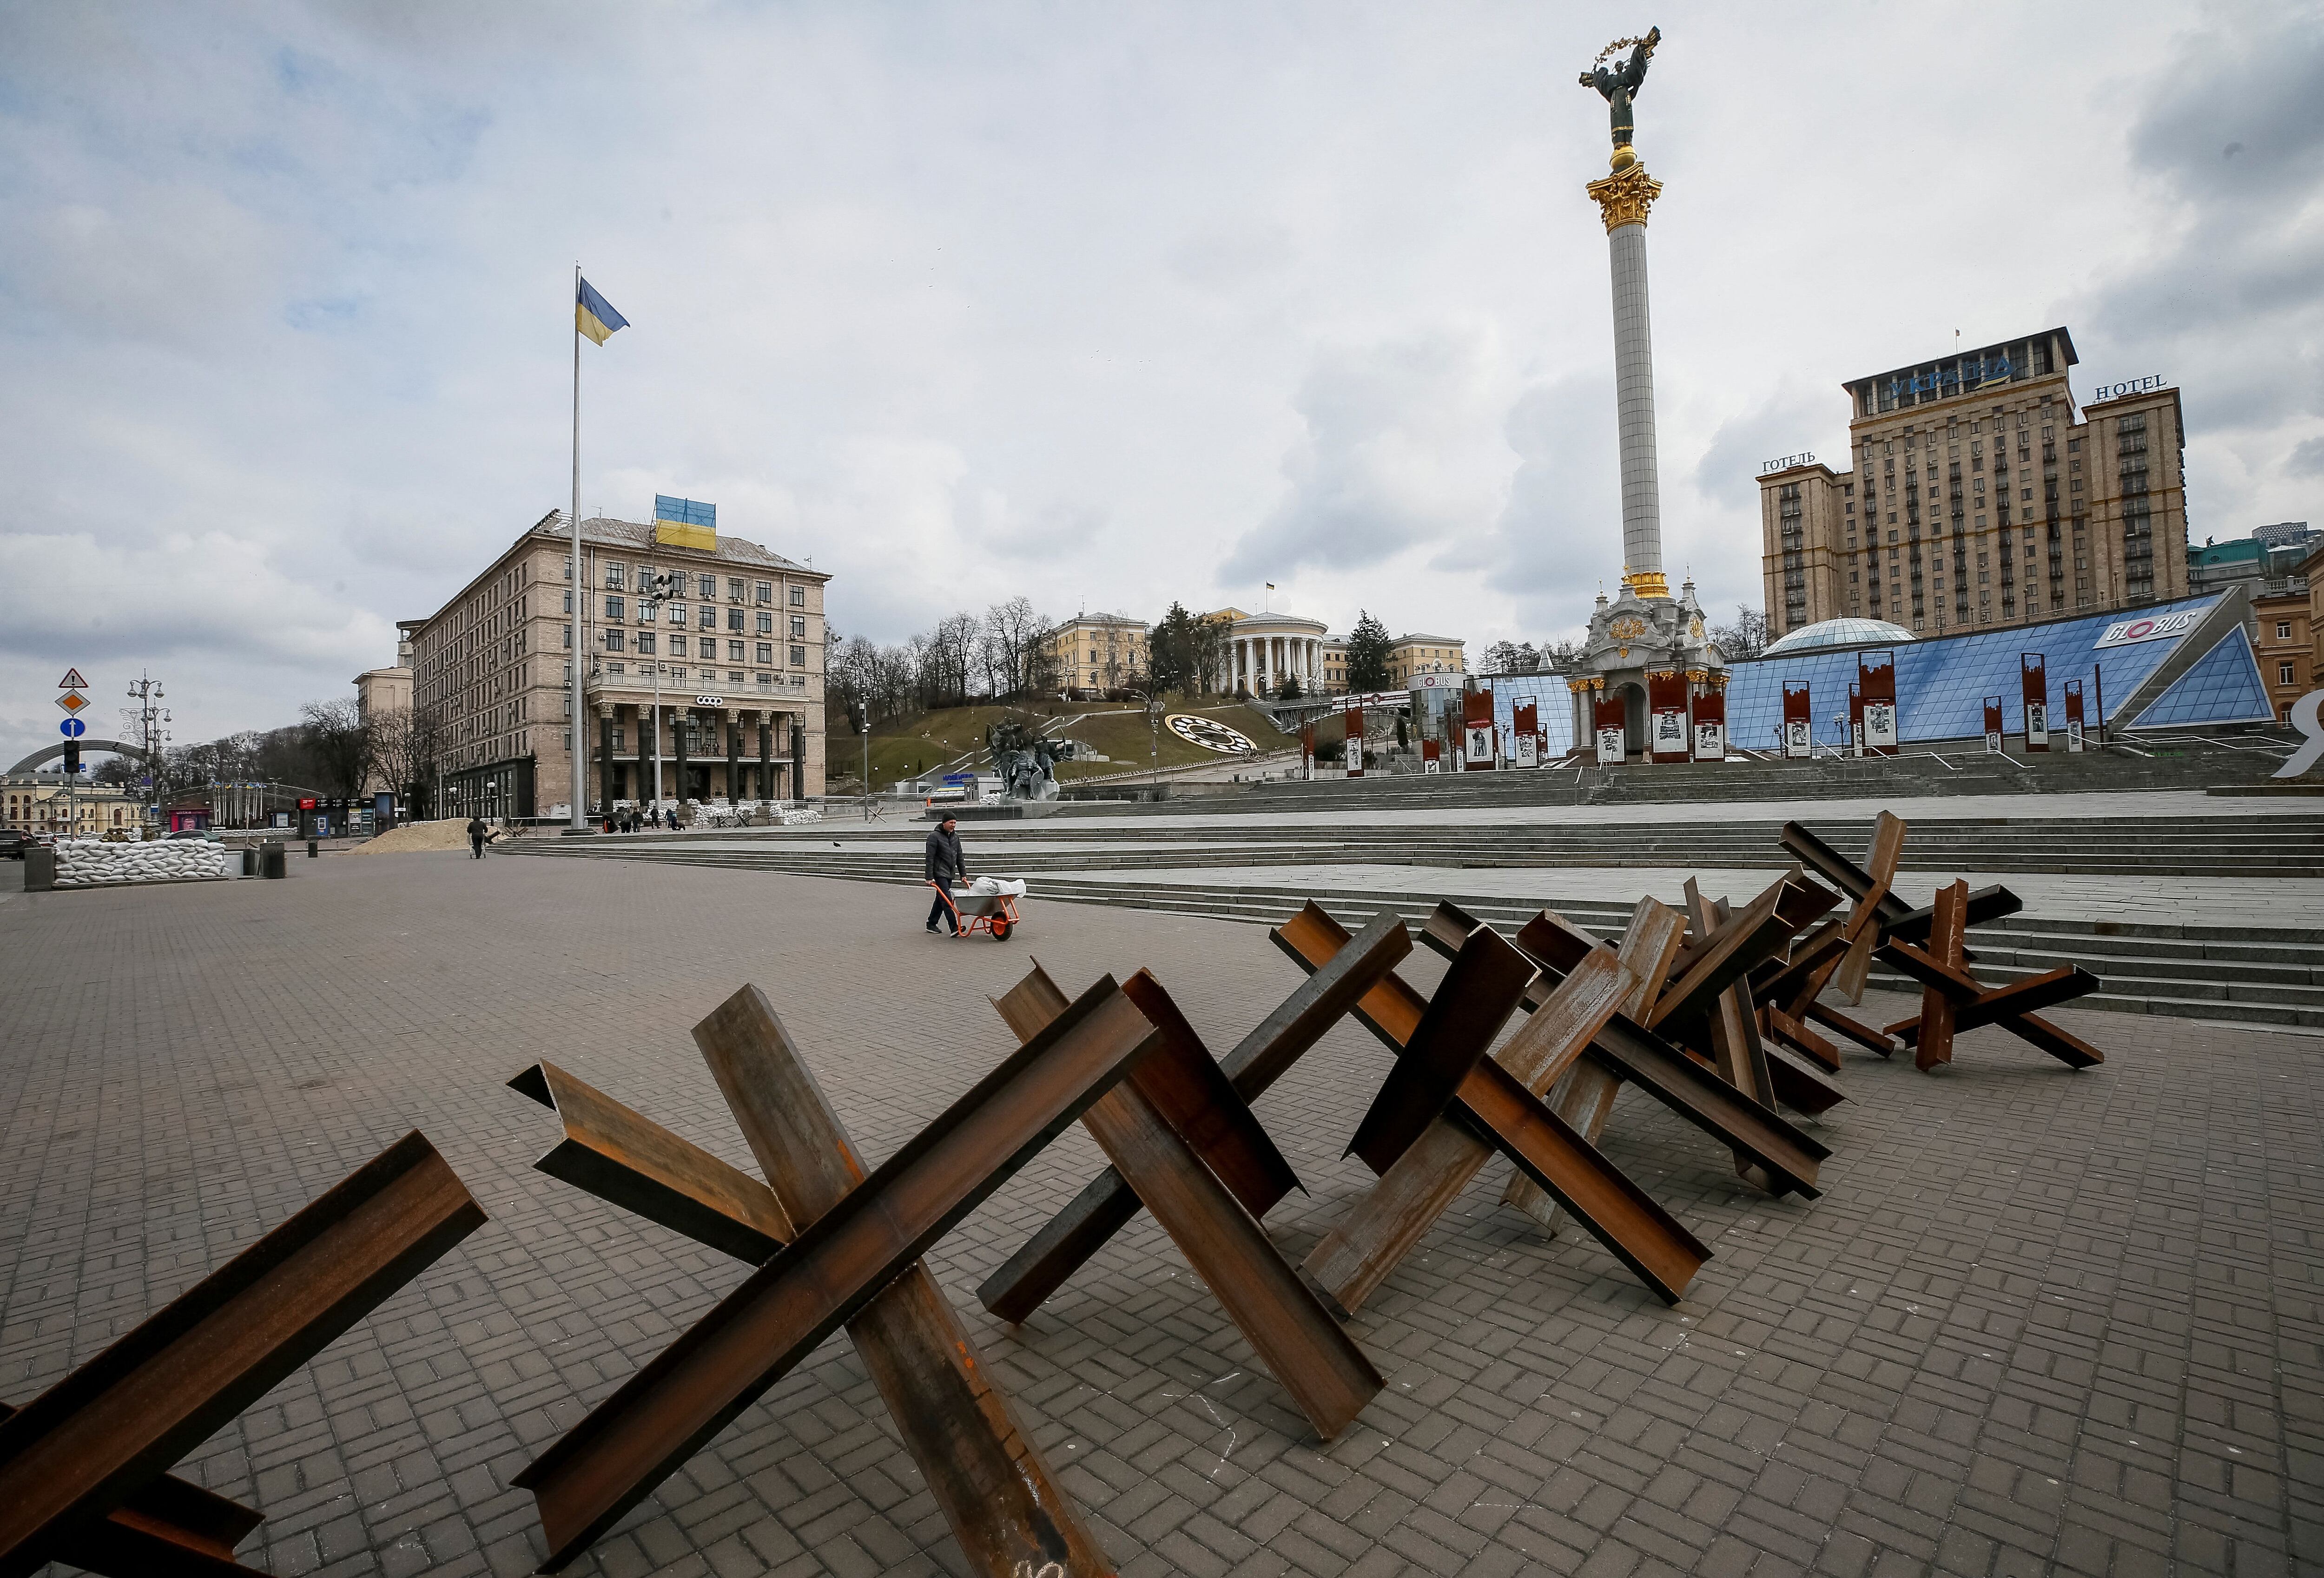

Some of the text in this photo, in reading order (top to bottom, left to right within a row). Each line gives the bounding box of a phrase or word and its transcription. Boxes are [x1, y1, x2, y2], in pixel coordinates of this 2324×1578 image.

[1889, 355, 2016, 399] УКРАЇНА
[2095, 374, 2168, 400] HOTEL
[1762, 452, 1816, 472] ГОТЕЛЬ
[2106, 611, 2197, 641] GLOBUS
[1418, 676, 1450, 687] GLOBUS
[697, 696, 723, 707] coop
